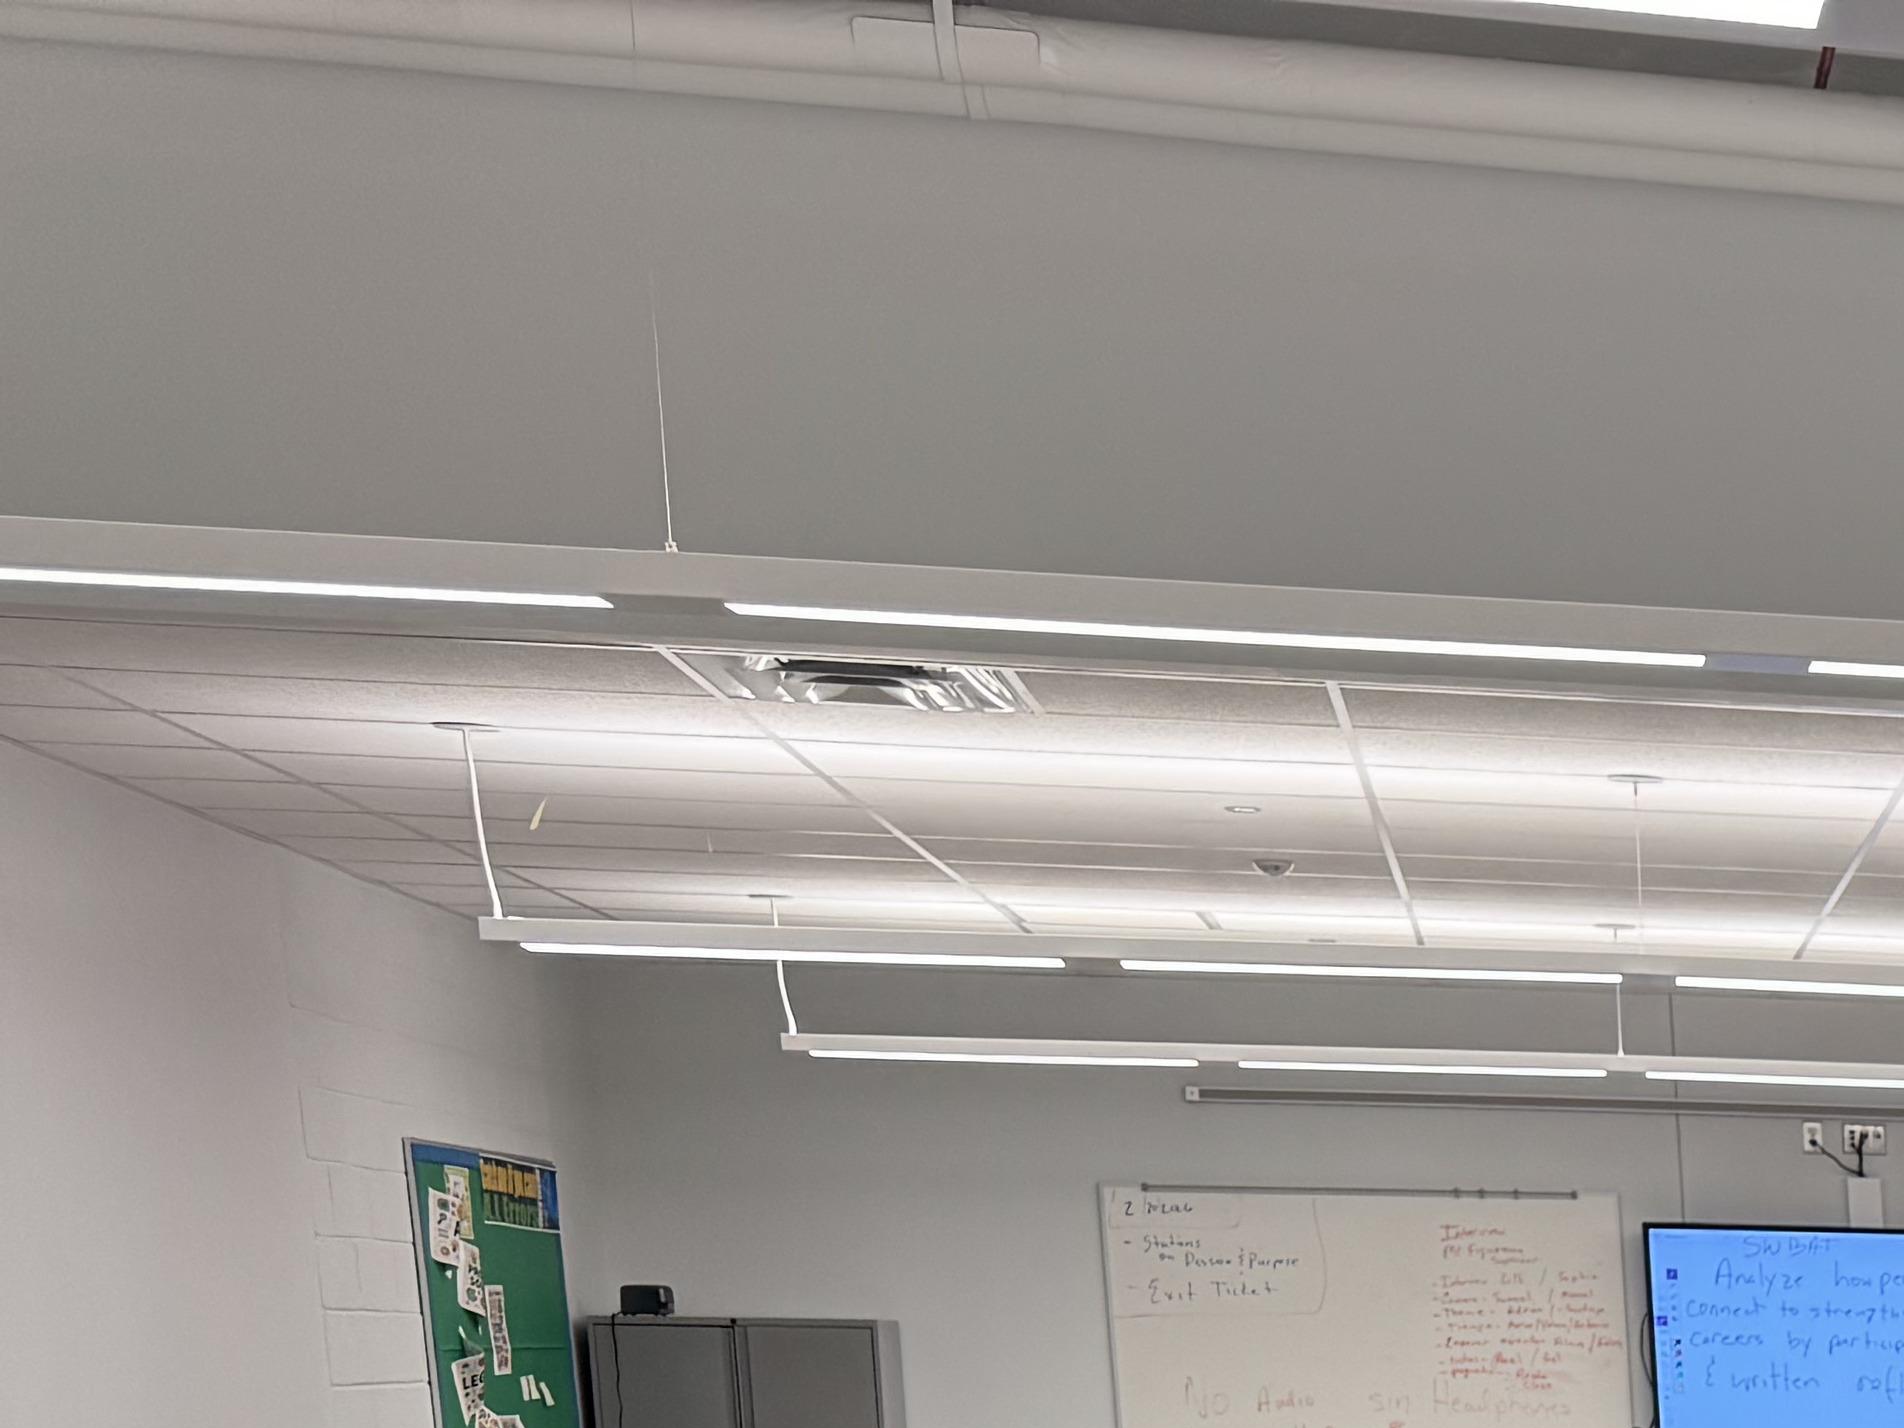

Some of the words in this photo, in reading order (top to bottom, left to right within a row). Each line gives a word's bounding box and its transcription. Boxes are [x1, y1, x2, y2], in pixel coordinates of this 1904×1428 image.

[1715, 1257, 1804, 1296] Analyze
[1148, 1278, 1199, 1305] Exit
[1209, 1281, 1279, 1298] Ticket
[1781, 1300, 1800, 1316] to
[1788, 1331, 1812, 1358] by
[1731, 1362, 1821, 1392] written
